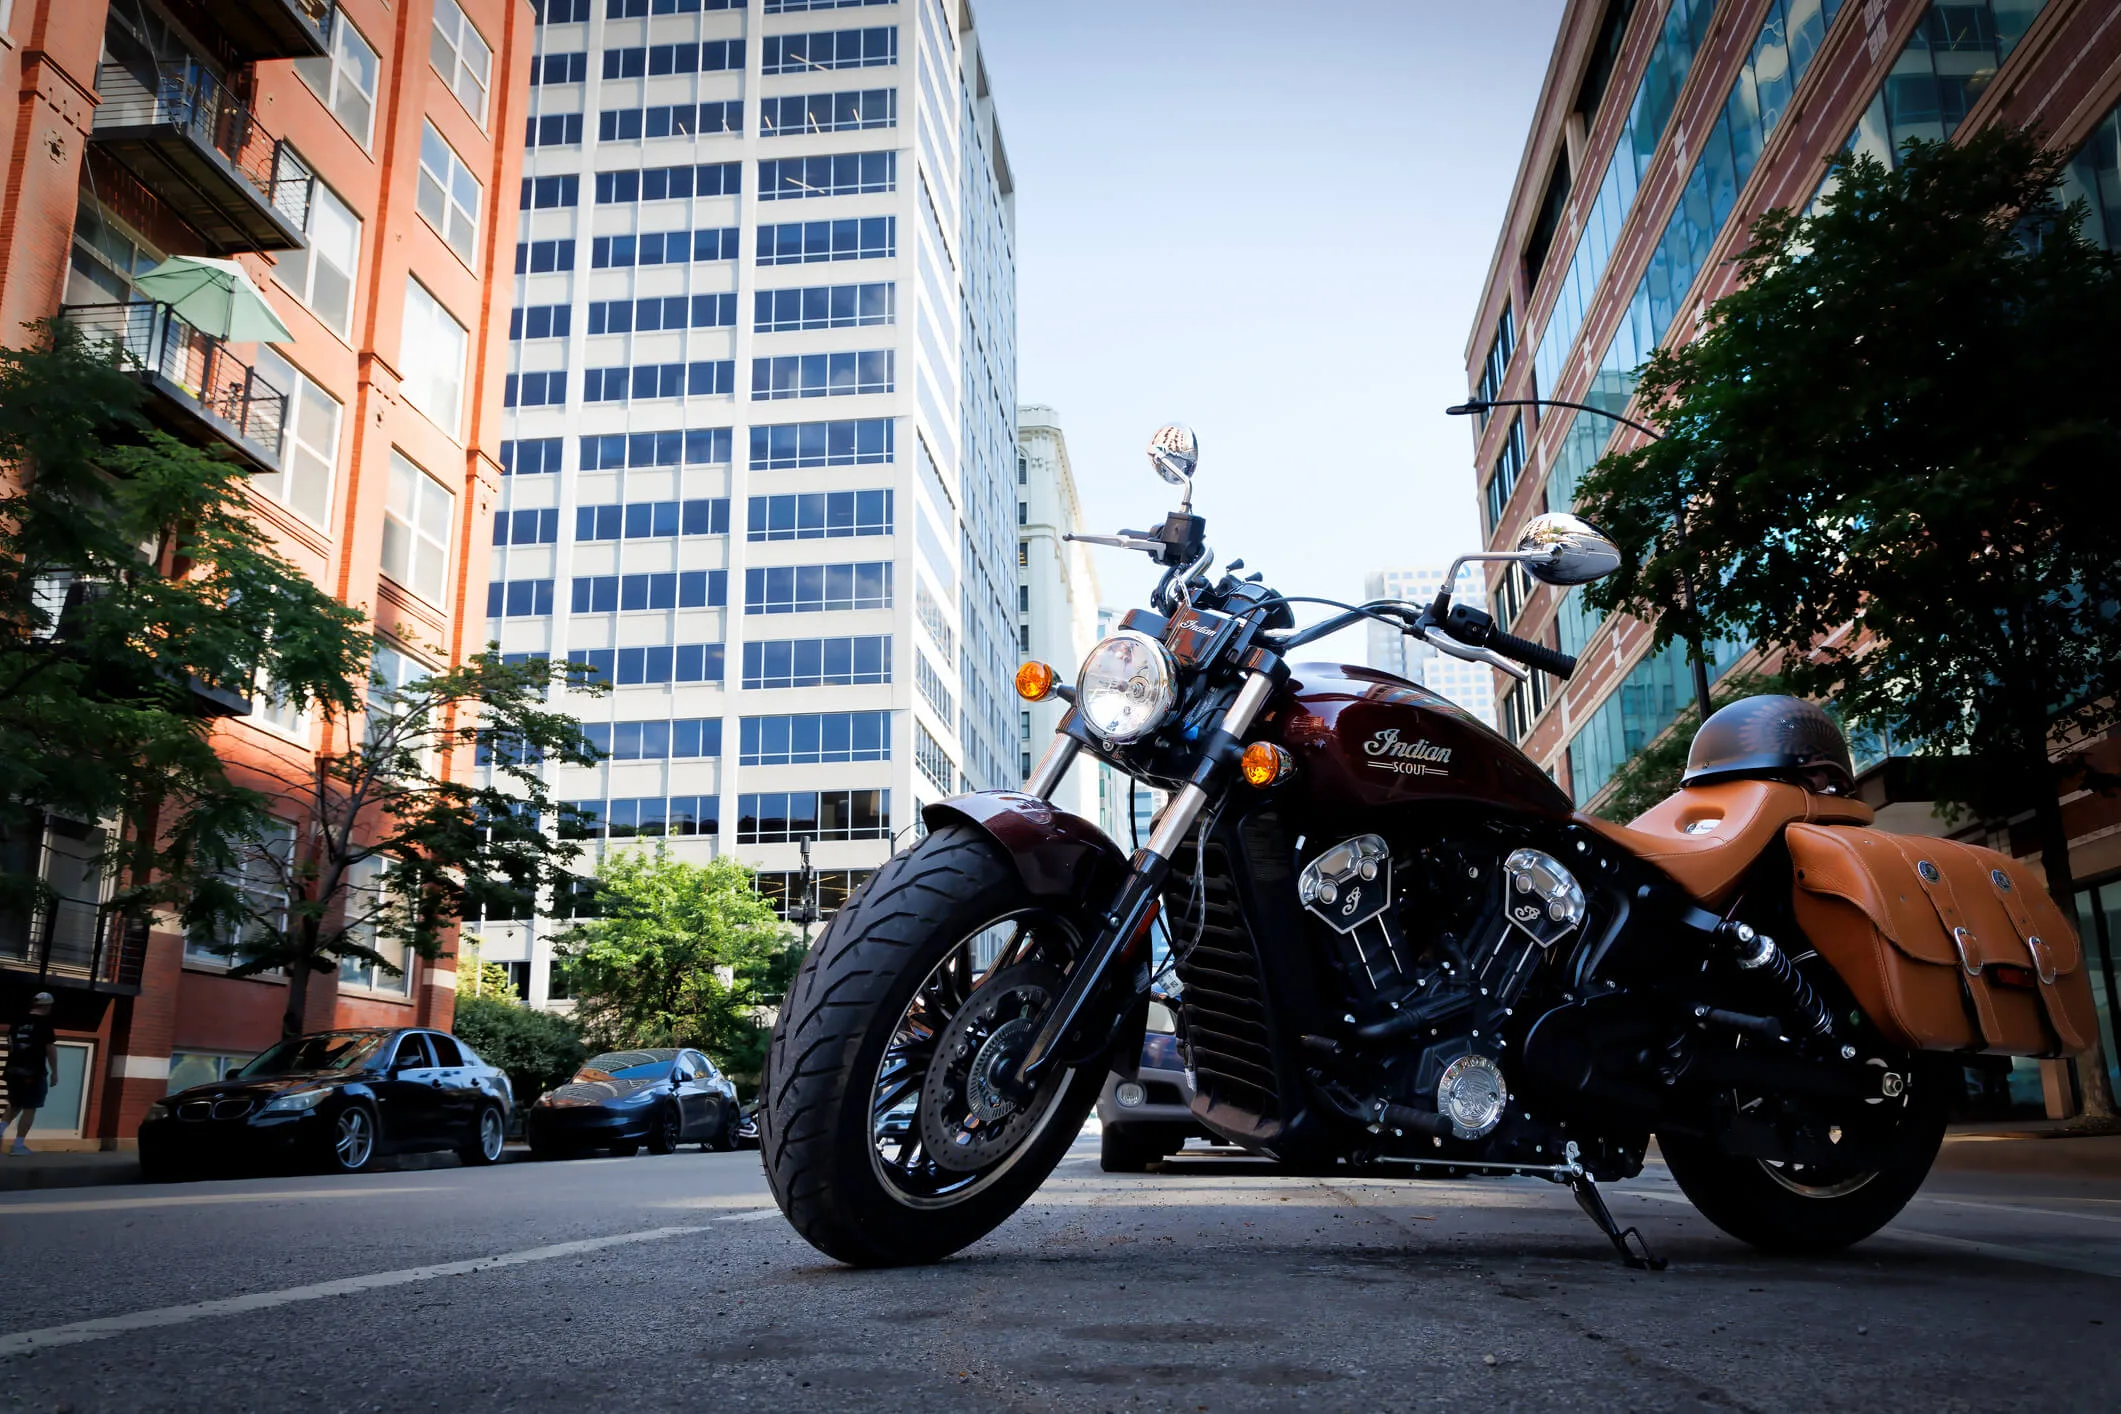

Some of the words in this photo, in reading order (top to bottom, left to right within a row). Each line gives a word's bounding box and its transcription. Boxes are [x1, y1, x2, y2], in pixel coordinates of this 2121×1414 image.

[1181, 620, 1217, 637] Indian
[1363, 728, 1452, 763] Indian
[1393, 761, 1426, 776] SCOUT
